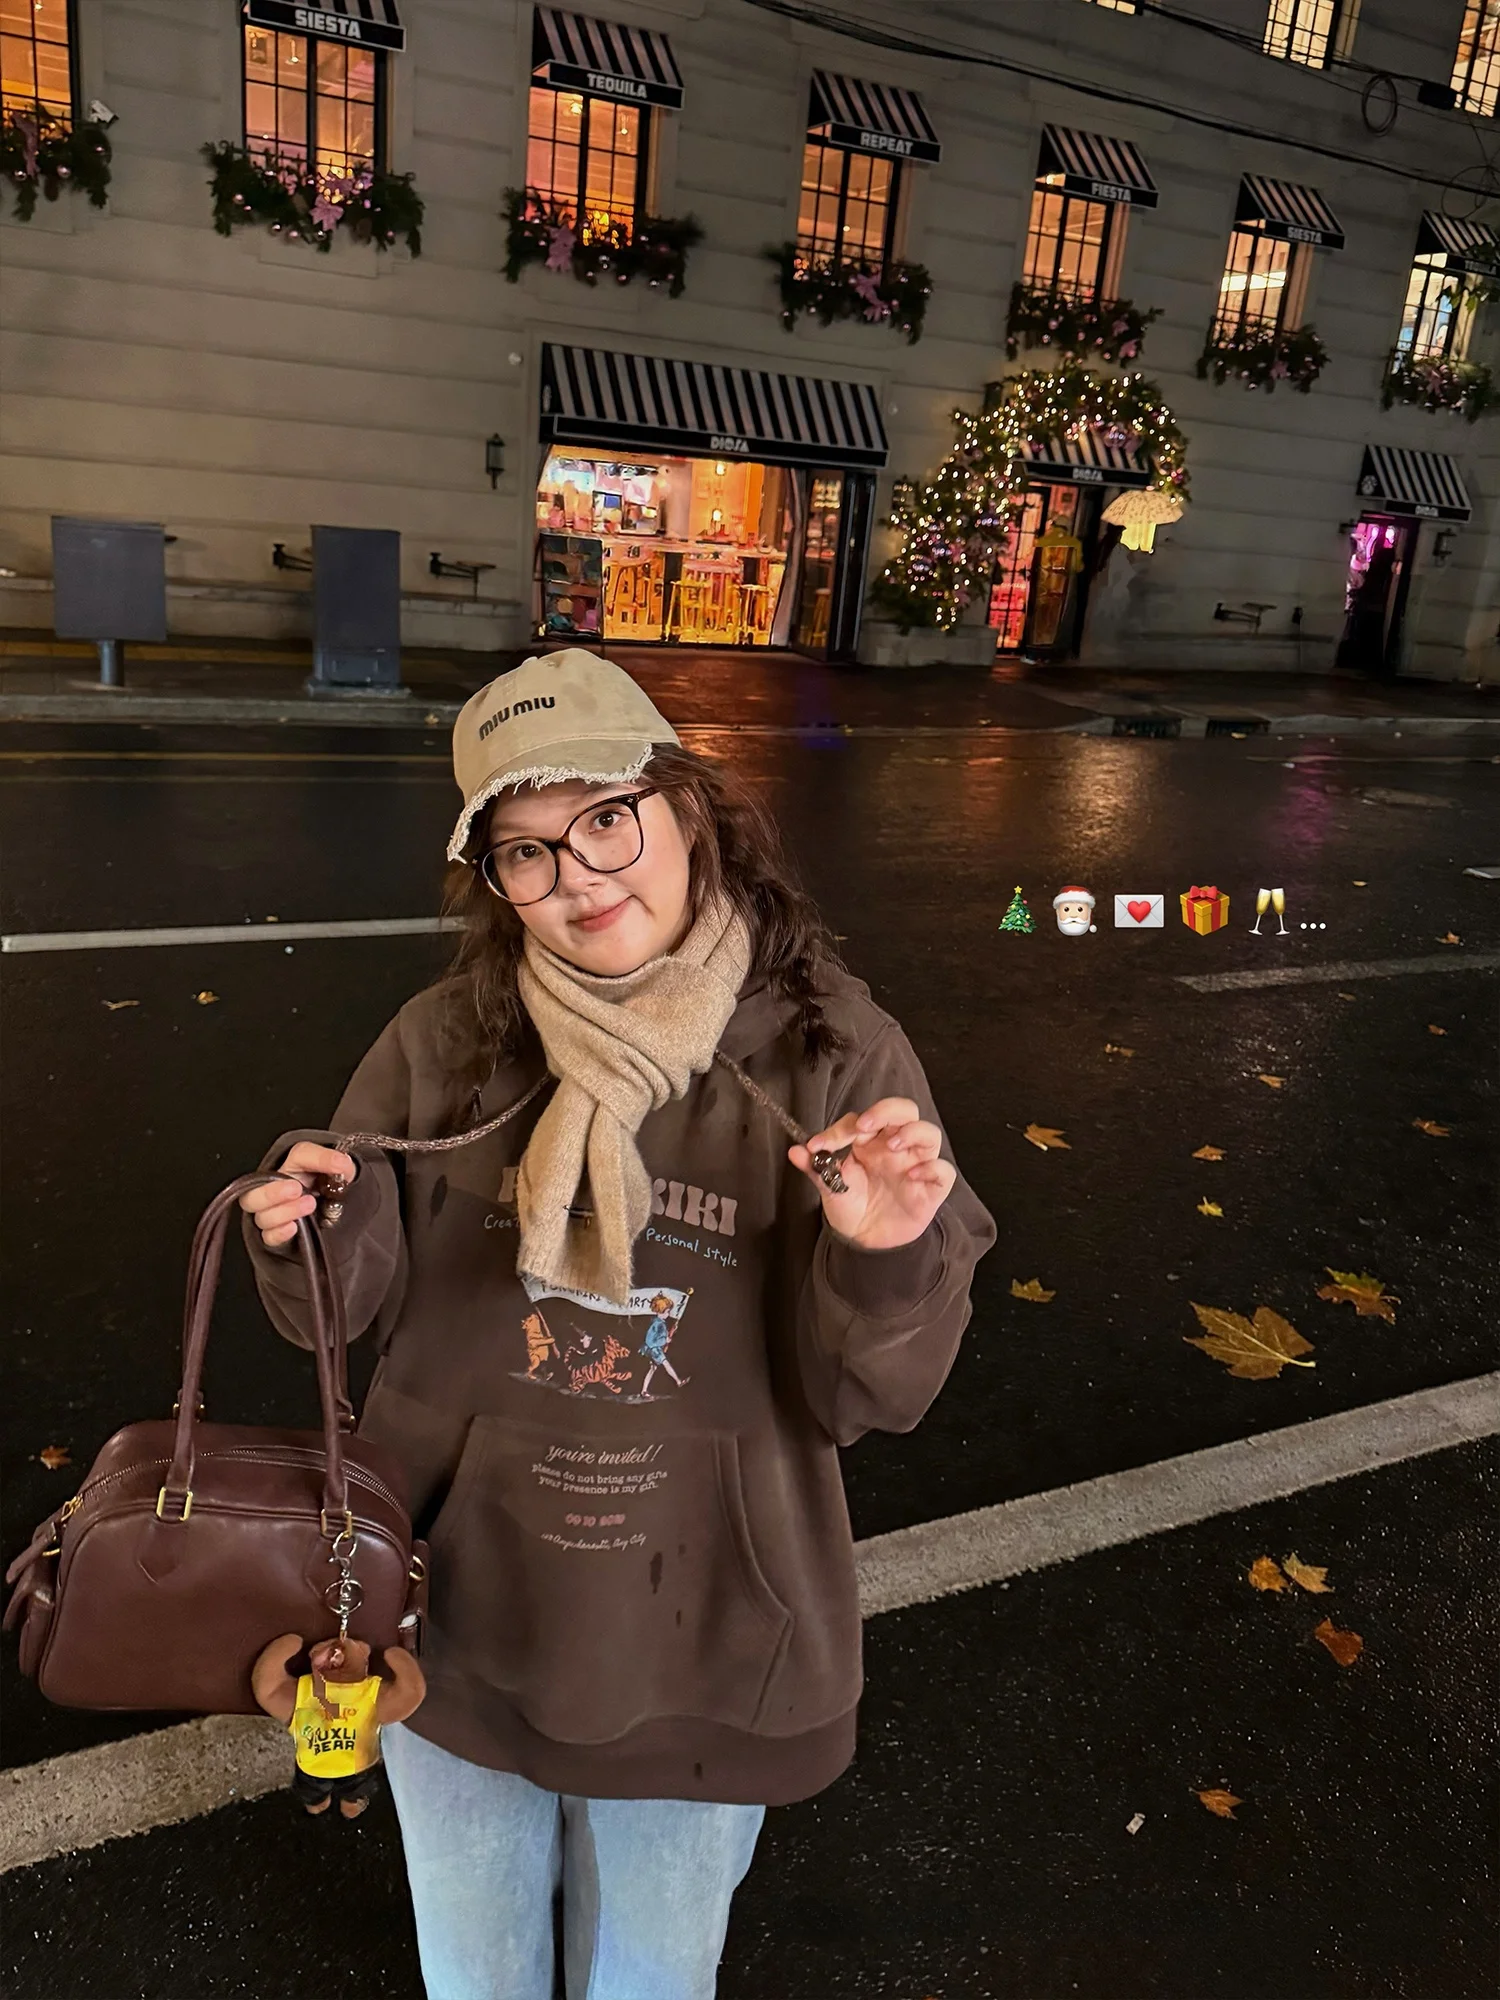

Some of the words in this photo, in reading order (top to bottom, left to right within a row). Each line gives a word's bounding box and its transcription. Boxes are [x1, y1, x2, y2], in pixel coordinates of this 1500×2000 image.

[295, 9, 361, 39] SIESTA
[587, 73, 647, 99] TEQUILA
[861, 132, 913, 155] REPEAT
[1091, 183, 1131, 202] FIESTA
[1287, 226, 1322, 244] SIESTA
[646, 1228, 699, 1253] Personal
[704, 1246, 738, 1267] style
[563, 1471, 576, 1481] do
[578, 1474, 594, 1484] not
[597, 1475, 625, 1485] bring
[563, 1483, 608, 1495] presence
[610, 1484, 620, 1494] is
[621, 1484, 637, 1494] my
